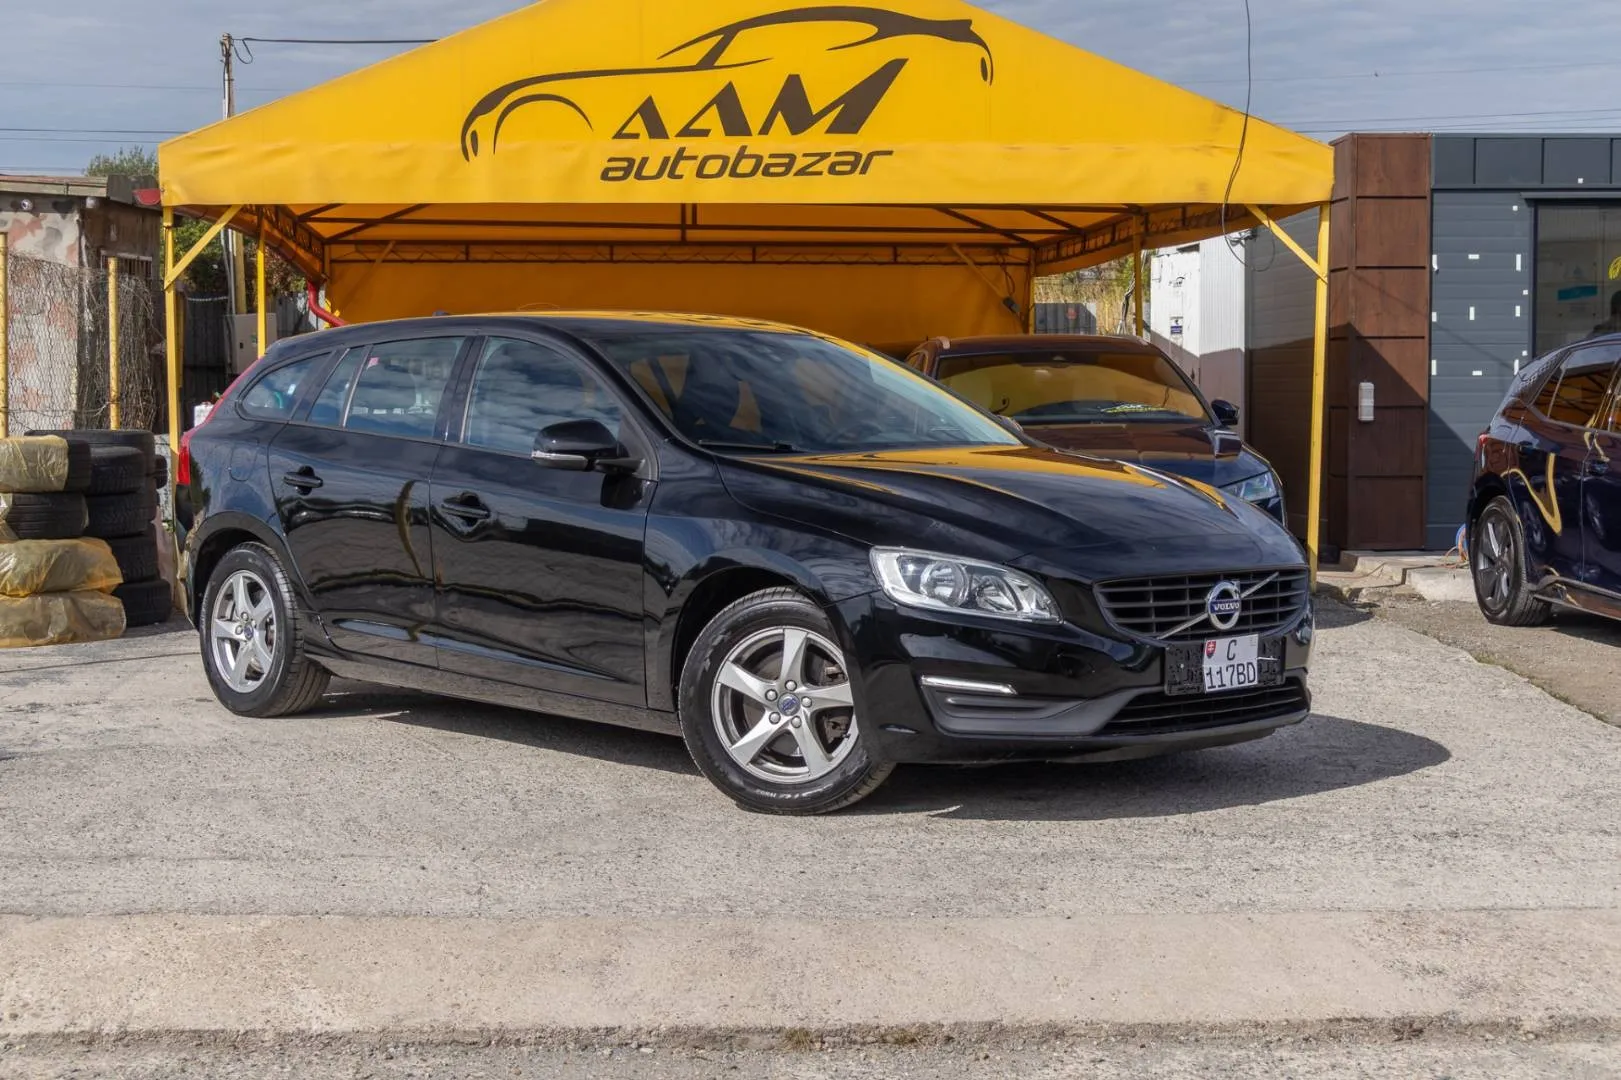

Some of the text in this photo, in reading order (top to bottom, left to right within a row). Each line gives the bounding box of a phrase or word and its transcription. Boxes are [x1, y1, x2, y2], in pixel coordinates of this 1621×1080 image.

[612, 58, 909, 139] AAM
[600, 145, 893, 182] autobazar
[1214, 602, 1240, 611] VOLVO
[1226, 639, 1237, 661] C
[1206, 662, 1256, 689] 117BD
